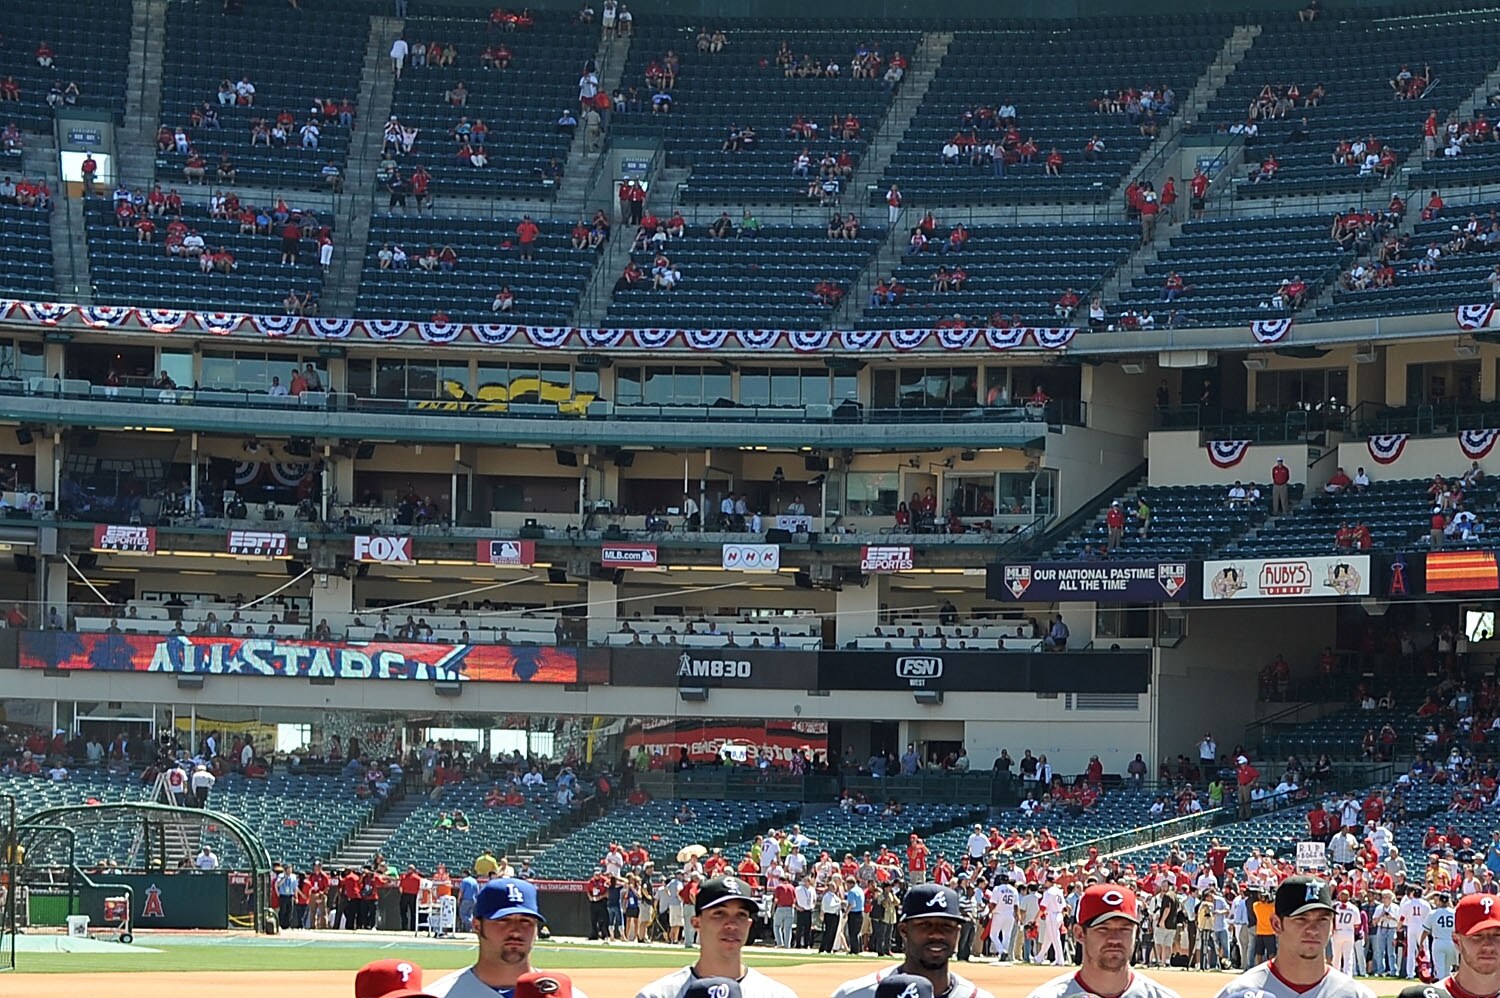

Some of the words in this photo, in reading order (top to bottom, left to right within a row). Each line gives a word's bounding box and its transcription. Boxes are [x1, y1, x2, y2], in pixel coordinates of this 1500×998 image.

[107, 526, 147, 537] ESPN
[101, 536, 149, 546] DEPORTES
[230, 531, 286, 547] ESPN
[231, 547, 282, 555] RADIO
[354, 536, 409, 561] FOX
[866, 547, 911, 560] ESPN
[605, 550, 641, 560] MLB.com
[861, 559, 913, 570] DEPORTES
[1161, 566, 1184, 575] MLB
[1007, 567, 1029, 576] MLB
[1034, 570, 1056, 580] OUR
[1059, 569, 1108, 580] NATIONAL
[1111, 568, 1155, 579] PASTIME
[1266, 566, 1306, 584] RUBY'S
[1059, 580, 1078, 590] ALL
[1080, 580, 1099, 590] THE
[1102, 580, 1127, 590] TIME
[902, 659, 938, 676] FSN
[506, 883, 523, 902] LA
[925, 891, 948, 908] A
[1412, 906, 1421, 917] 11
[1480, 898, 1494, 914] P
[1338, 912, 1352, 924] 10
[1437, 915, 1454, 928] 46
[396, 963, 412, 982] P
